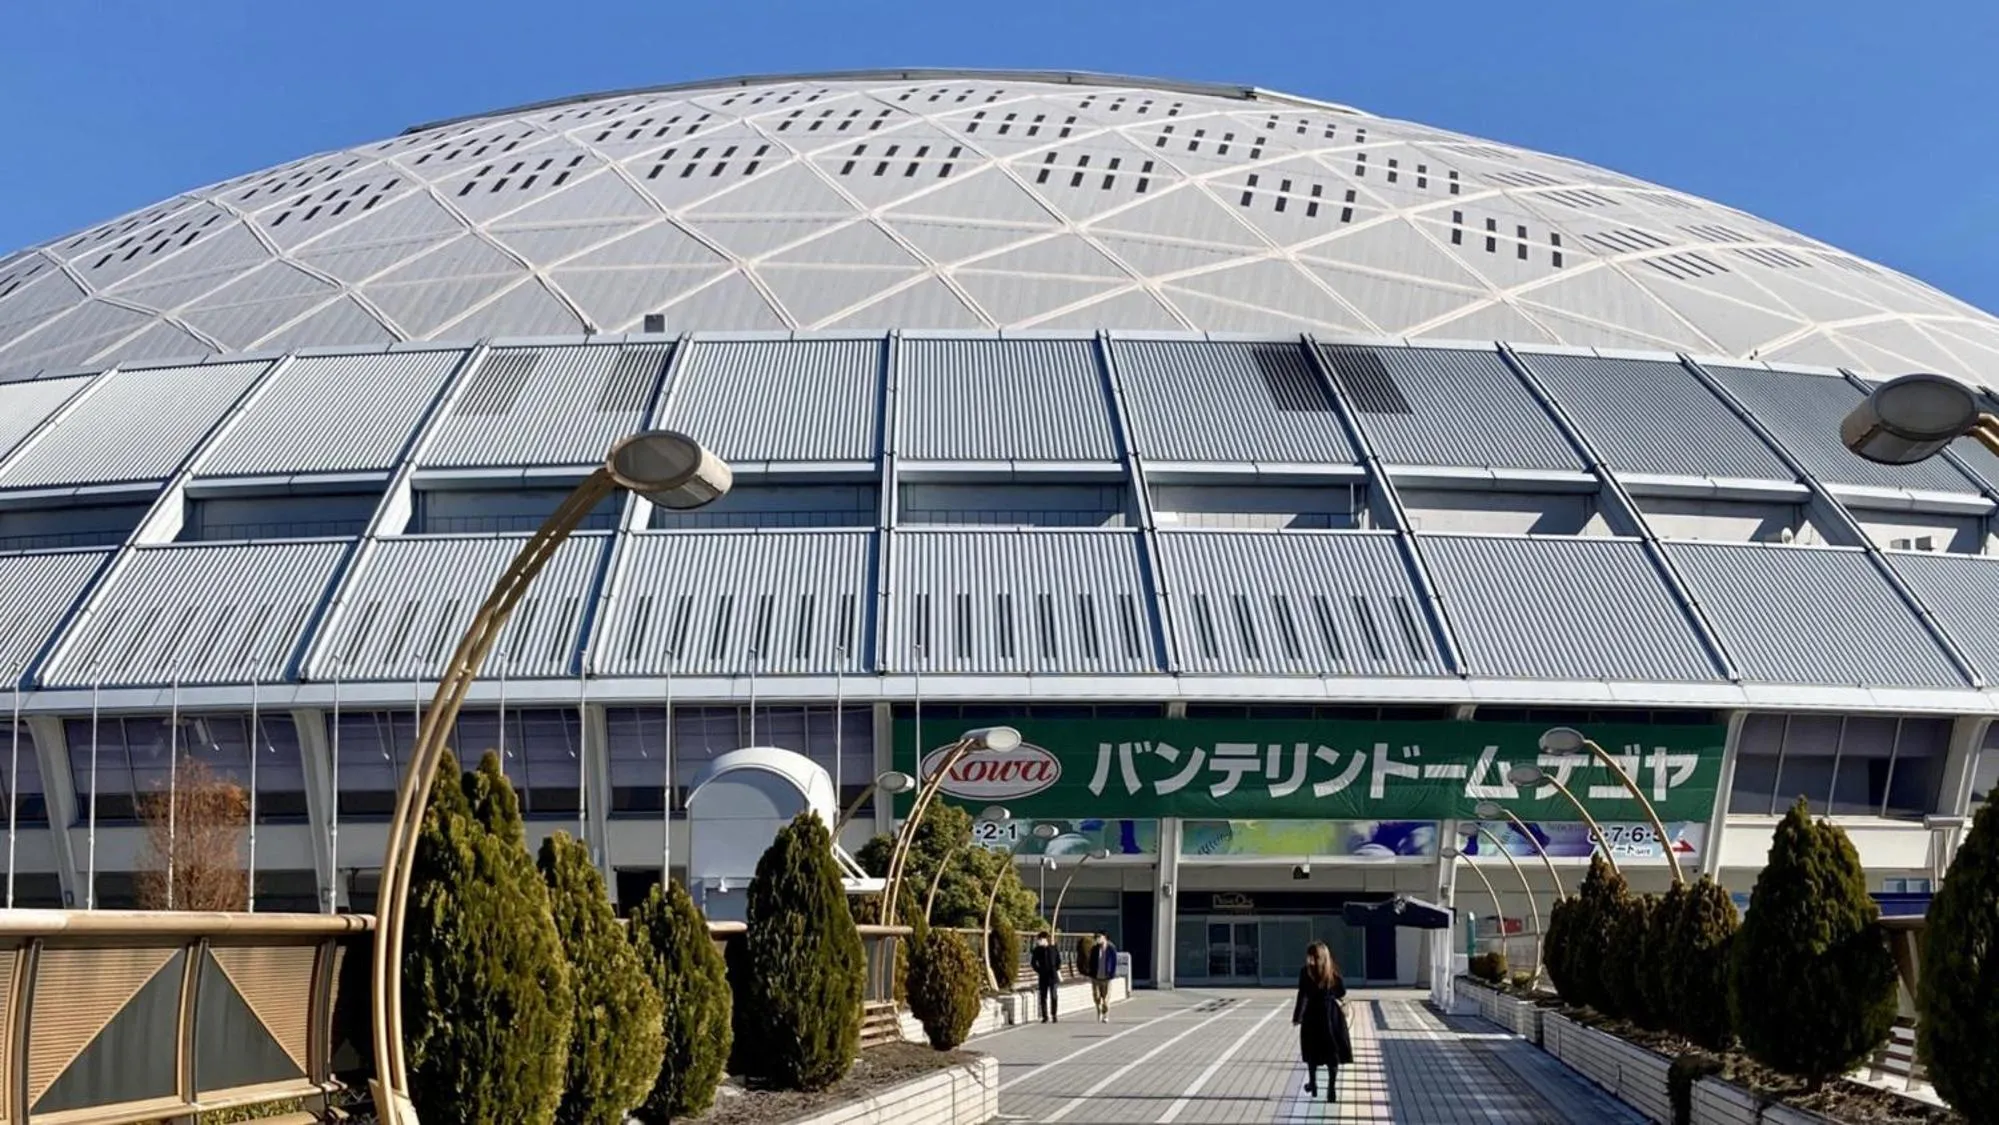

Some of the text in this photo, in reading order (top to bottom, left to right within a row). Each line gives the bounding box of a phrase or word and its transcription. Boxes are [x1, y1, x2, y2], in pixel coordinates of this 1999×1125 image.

[1087, 742, 1699, 801] バンテリンドームナゴヤ
